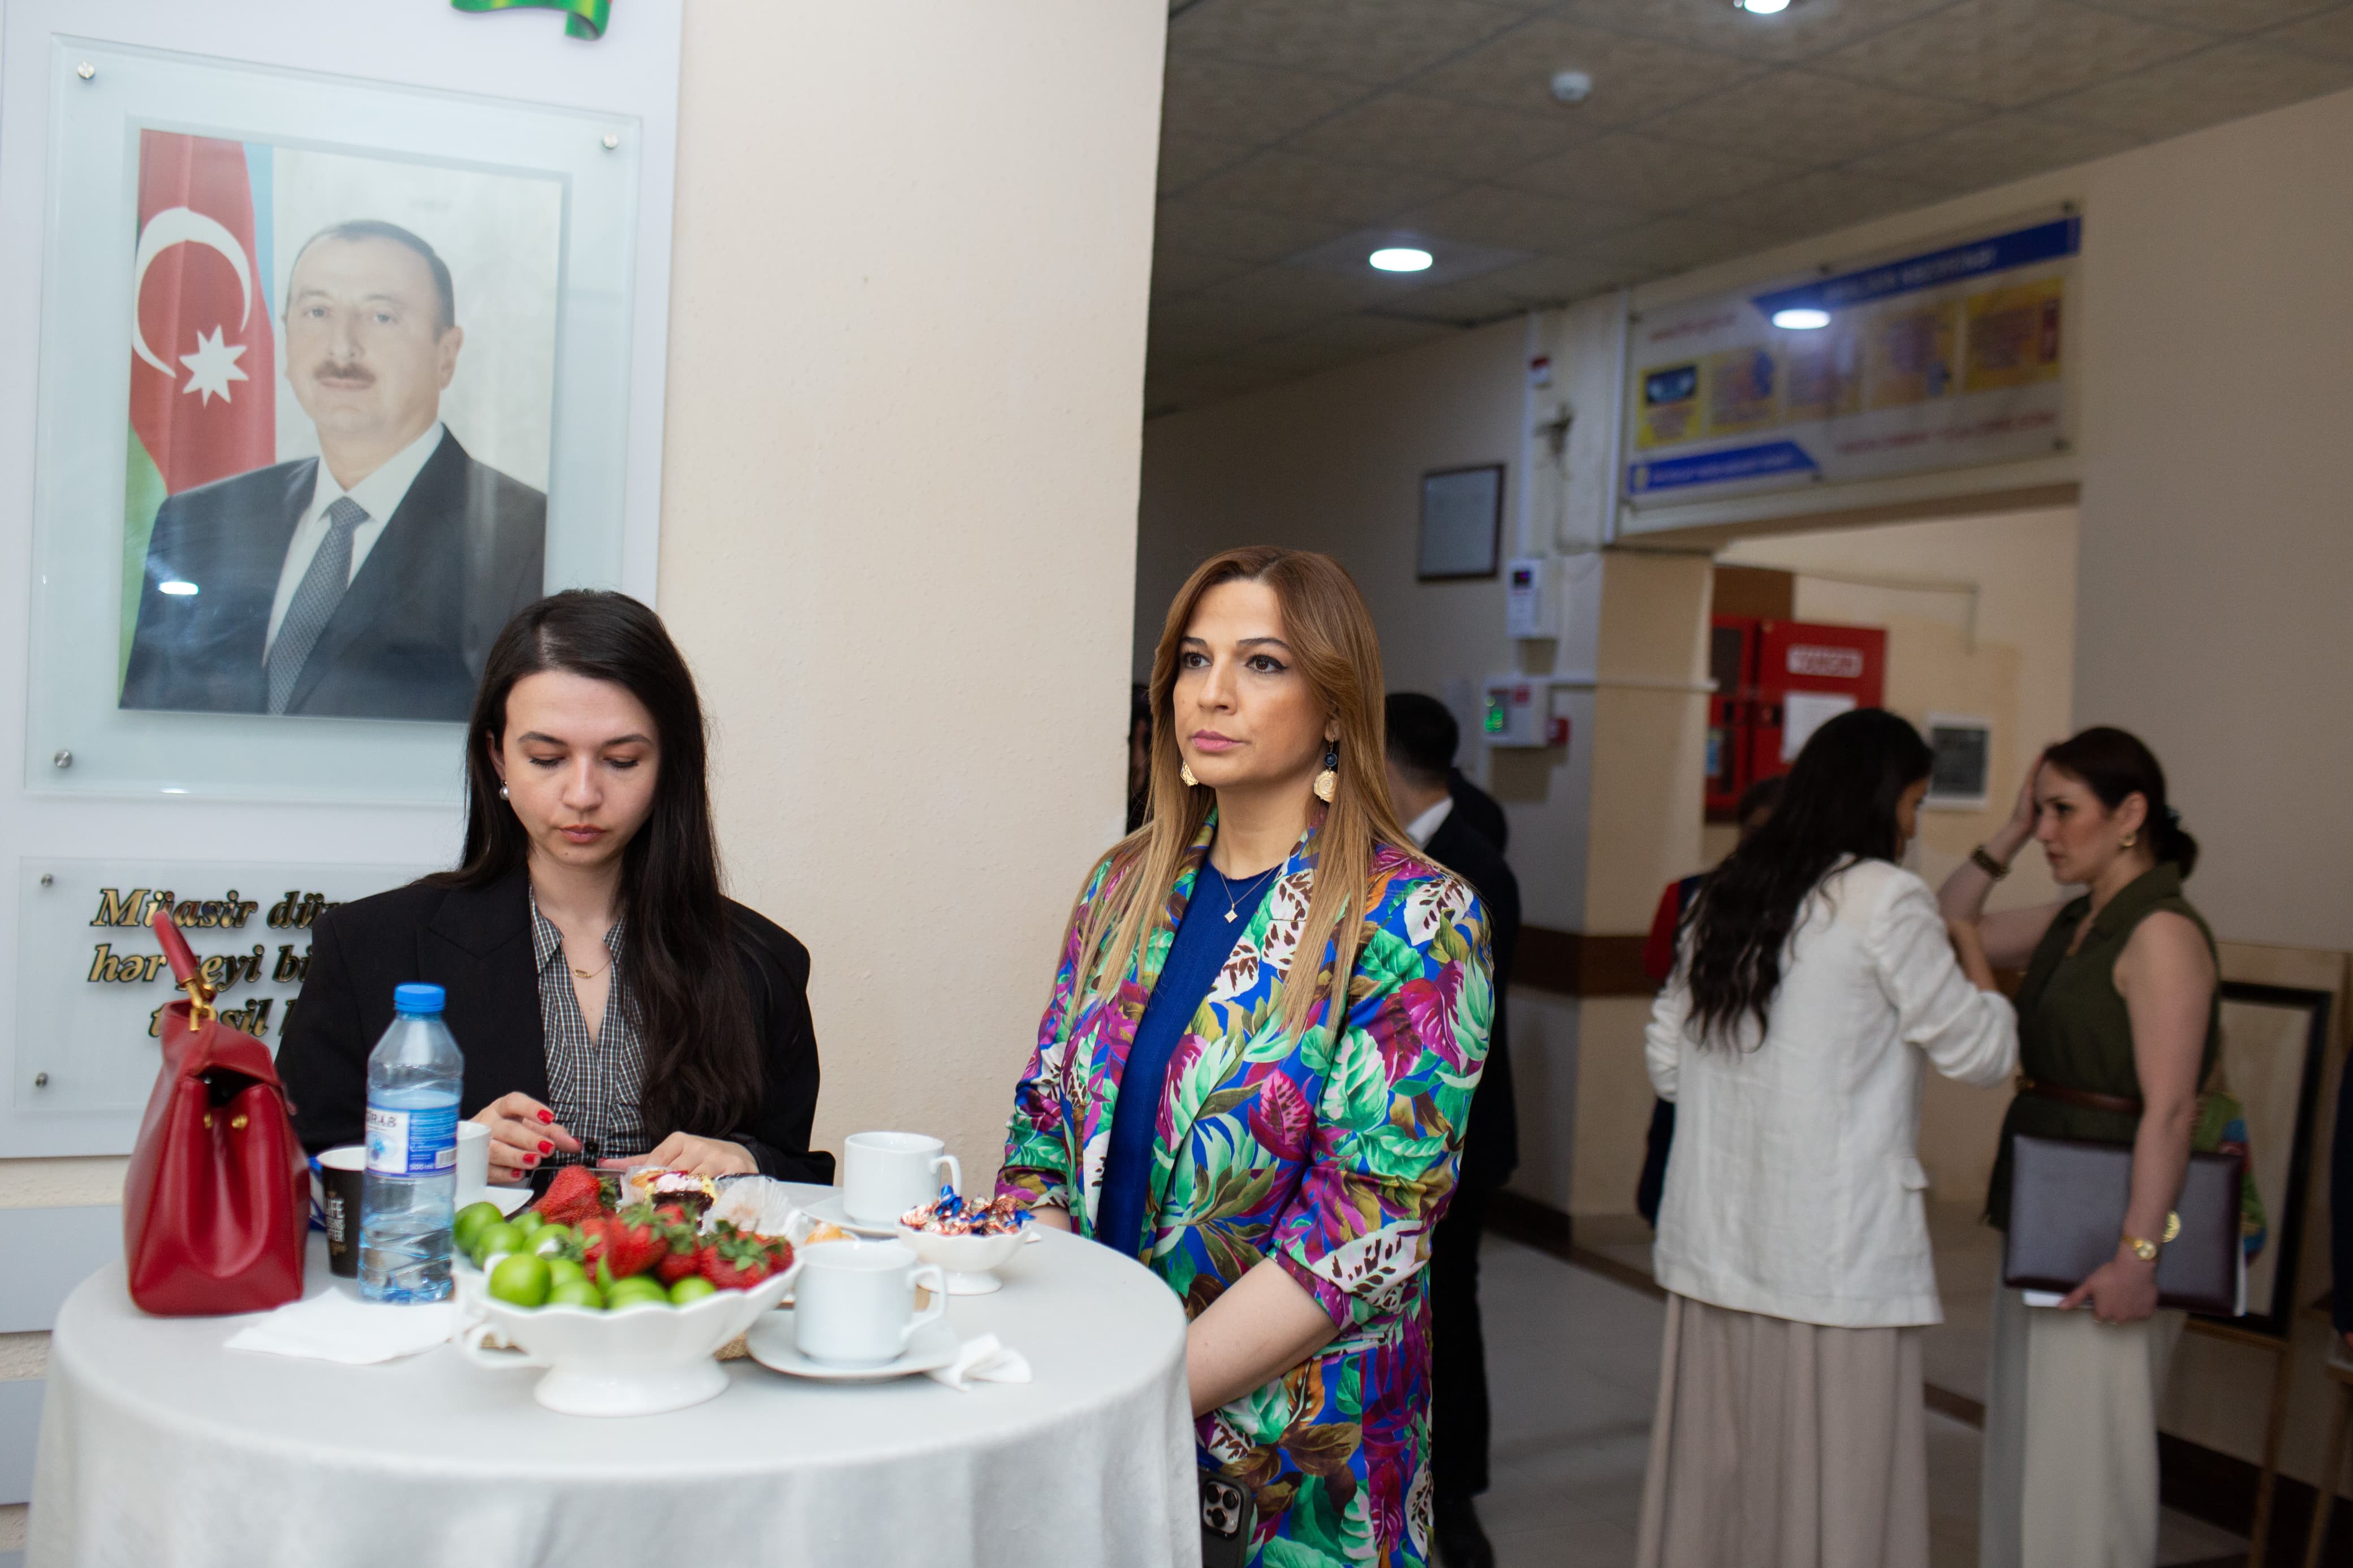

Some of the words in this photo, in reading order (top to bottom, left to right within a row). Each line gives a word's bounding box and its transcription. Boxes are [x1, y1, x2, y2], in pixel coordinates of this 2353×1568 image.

[89, 888, 259, 928] Müasir
[266, 890, 351, 929] dü
[87, 943, 168, 983] hər
[174, 944, 265, 993] eyi
[272, 944, 313, 983] bi
[148, 998, 274, 1037] tsil
